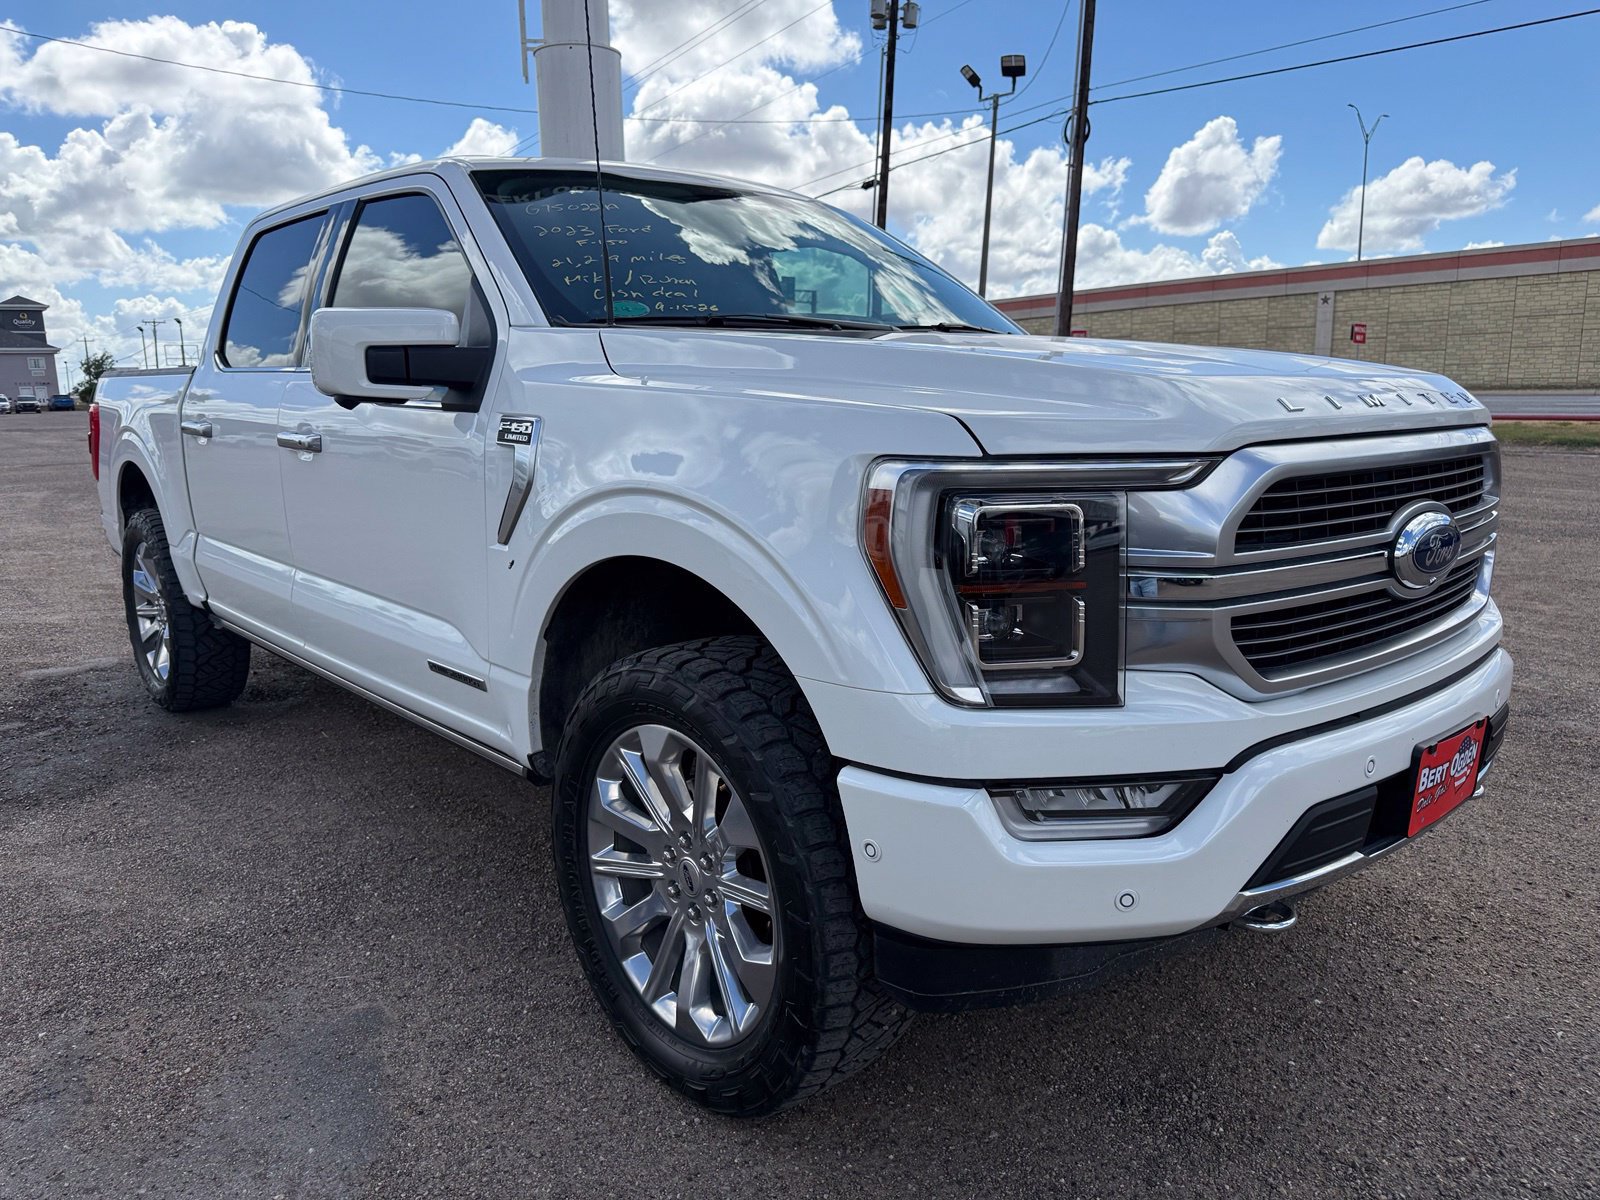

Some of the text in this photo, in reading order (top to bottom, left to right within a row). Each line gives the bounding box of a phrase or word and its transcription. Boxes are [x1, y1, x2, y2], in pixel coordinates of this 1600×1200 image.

[533, 225, 595, 237] 2023
[552, 254, 619, 267] 21,29
[564, 271, 614, 286] Mik
[499, 421, 532, 433] F-150
[504, 433, 528, 441] LIMITED
[1425, 533, 1455, 566] Ford
[1418, 742, 1478, 793] BERT OGDEN
